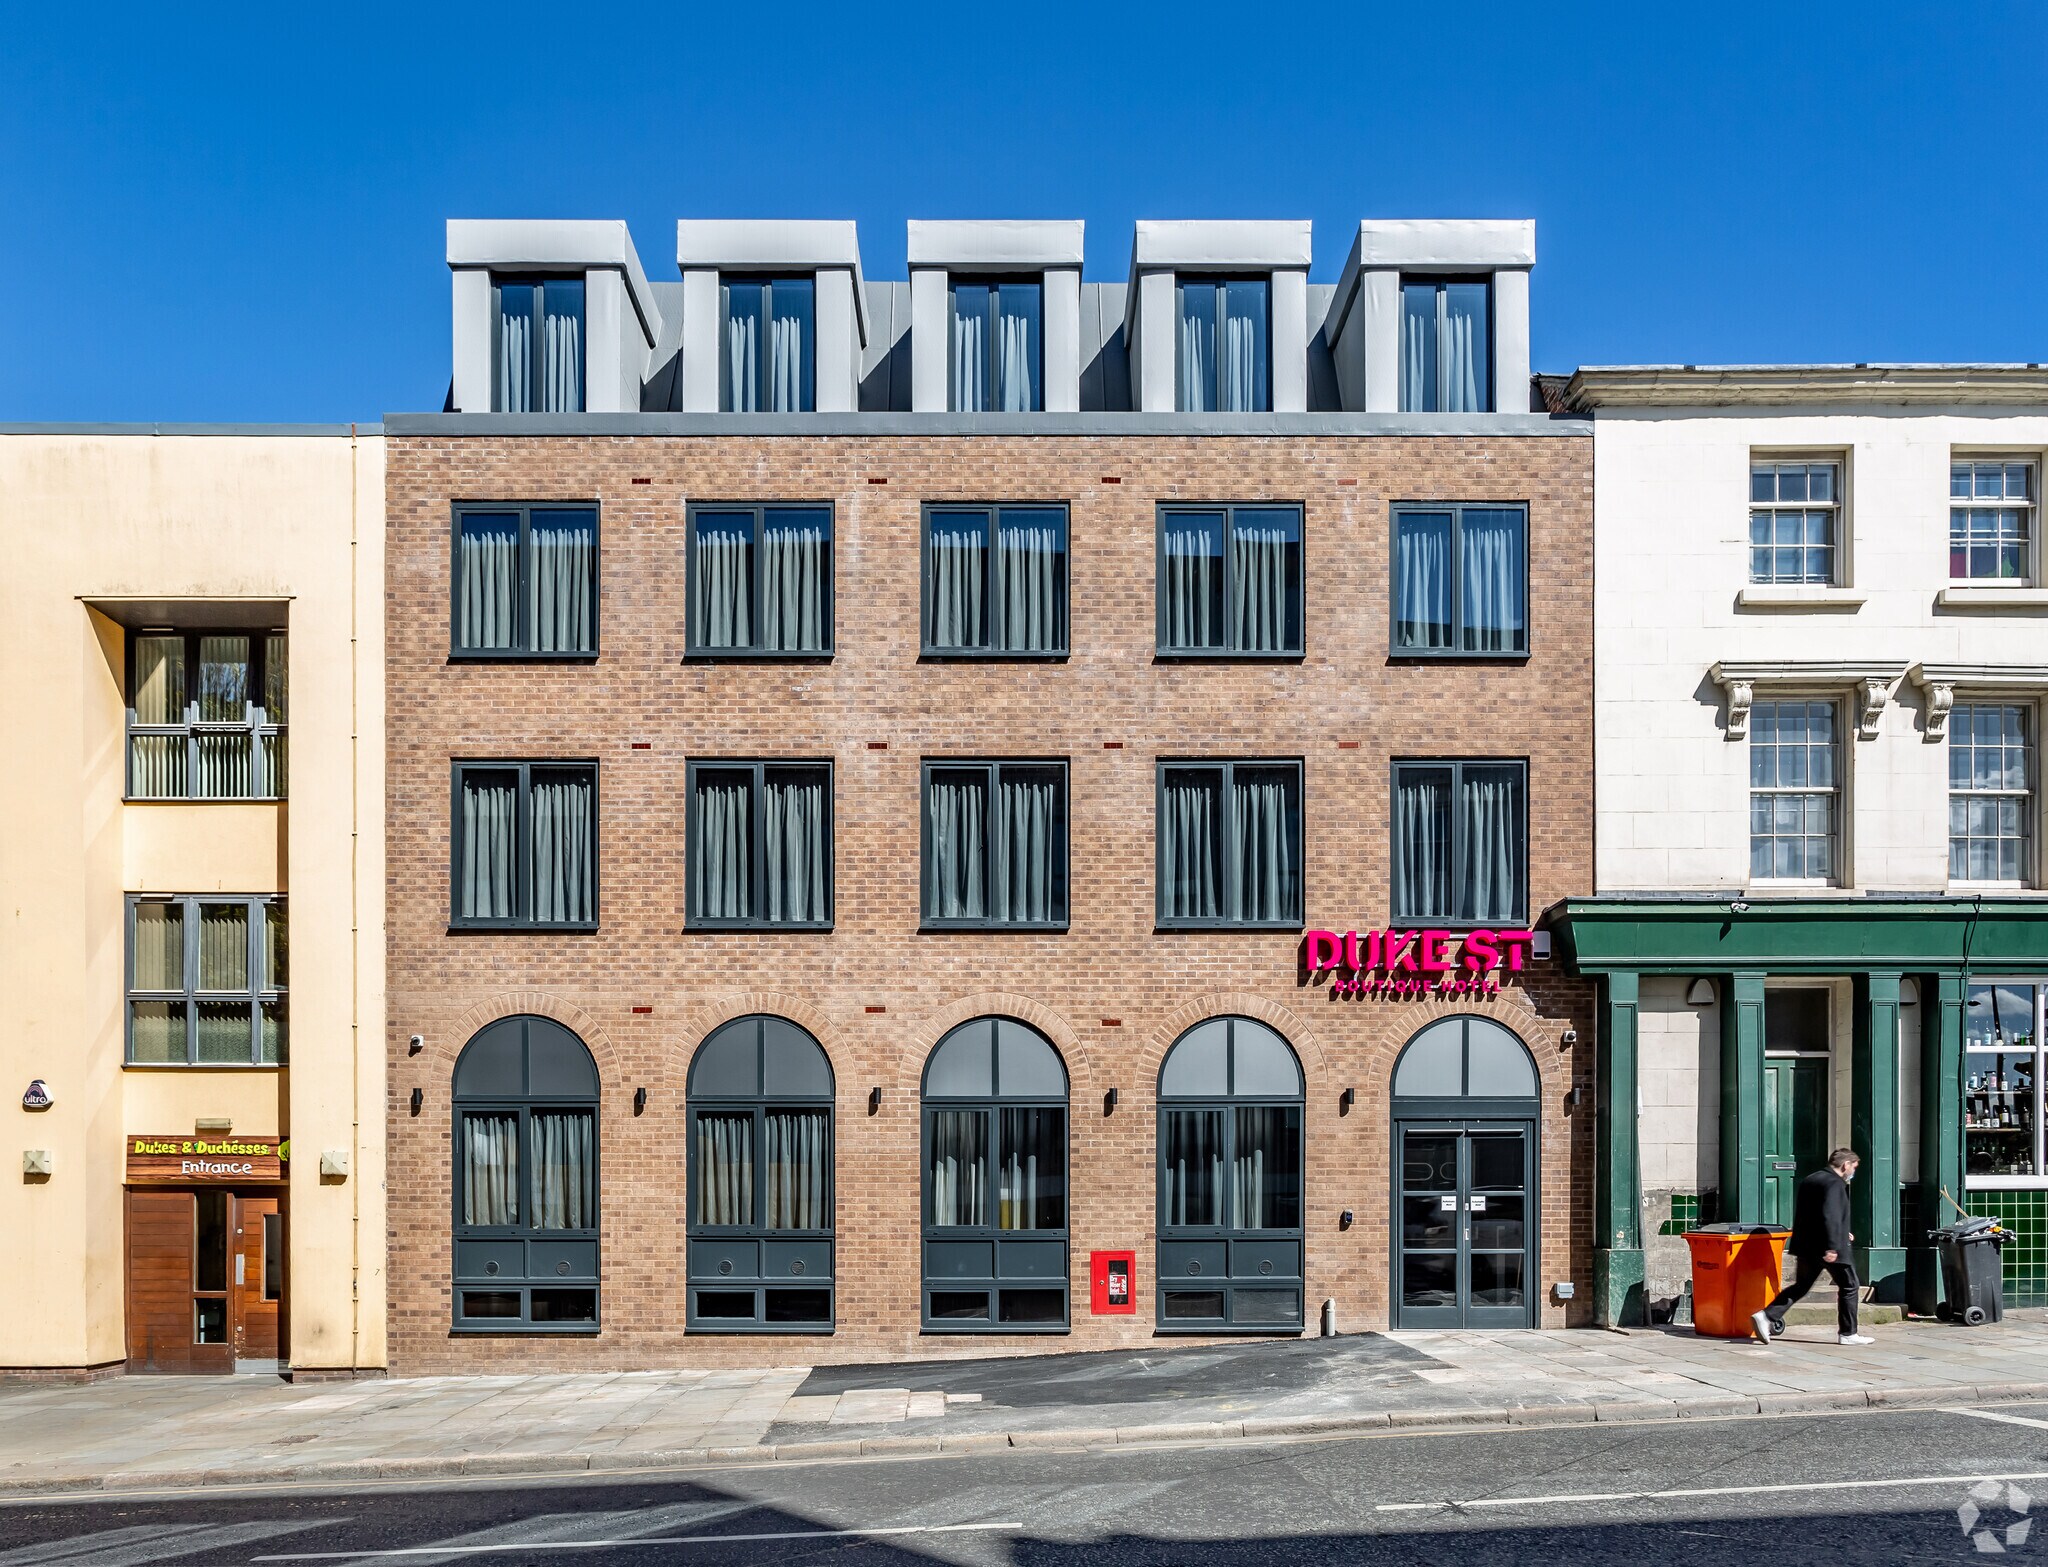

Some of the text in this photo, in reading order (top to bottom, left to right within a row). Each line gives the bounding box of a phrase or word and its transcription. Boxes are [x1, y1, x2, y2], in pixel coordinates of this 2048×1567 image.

[1306, 929, 1534, 972] DUKE ST
[1334, 979, 1502, 993] BOUTIQUE HOTEL
[134, 1140, 177, 1154] Dukes
[181, 1141, 192, 1154] &
[181, 1159, 253, 1174] Entrance
